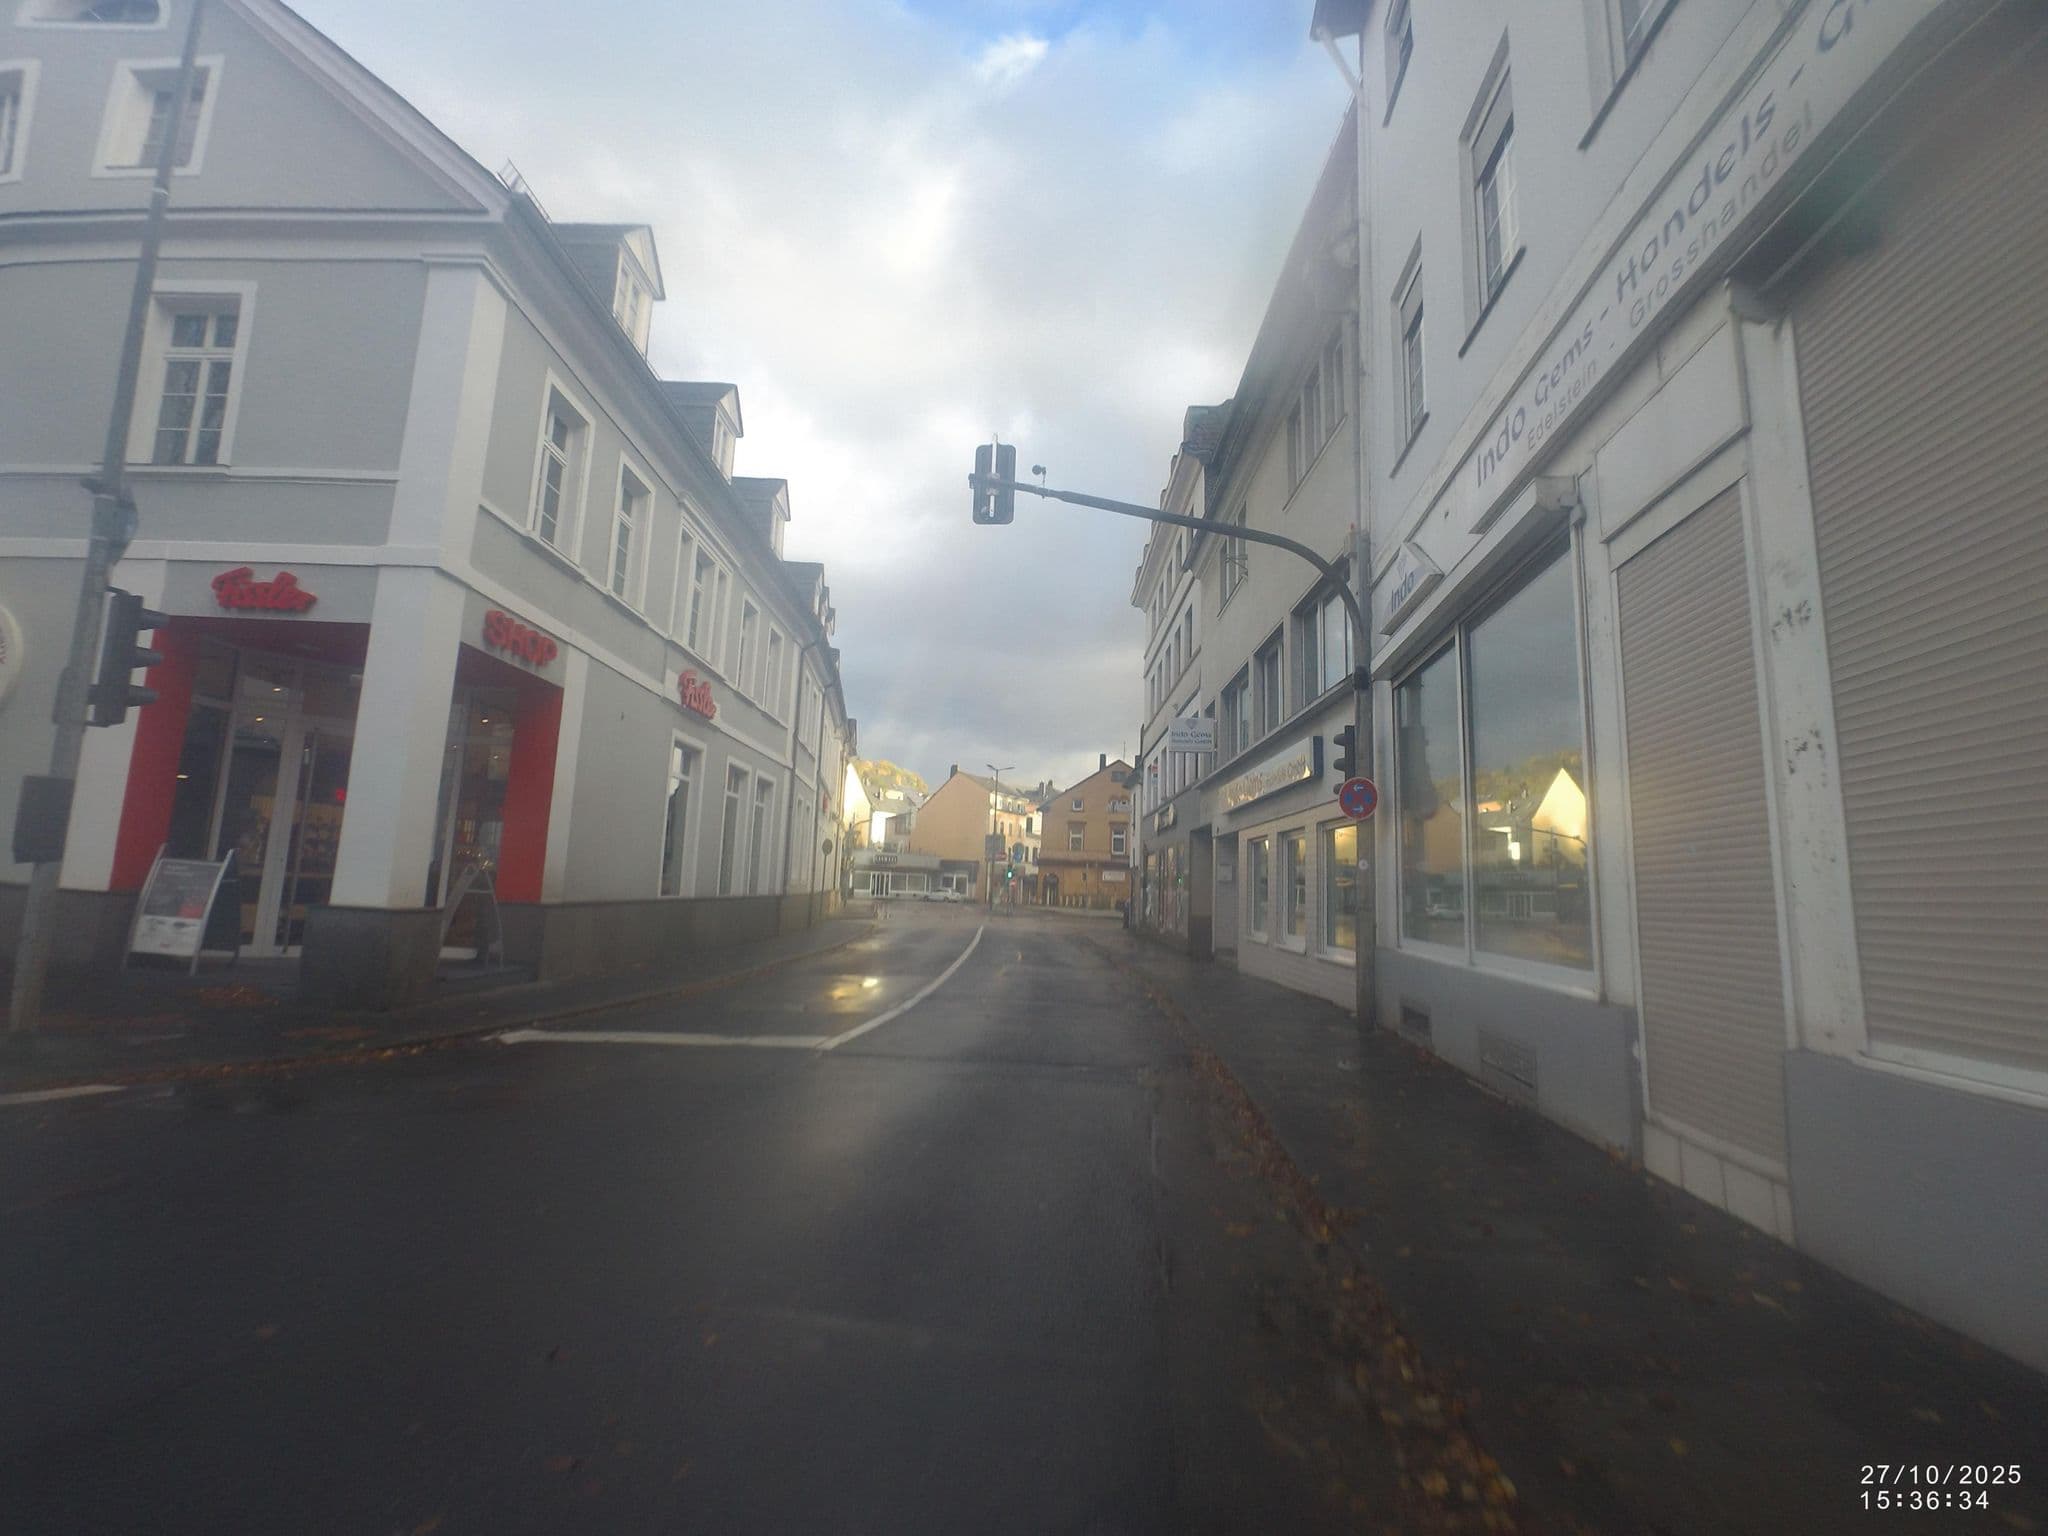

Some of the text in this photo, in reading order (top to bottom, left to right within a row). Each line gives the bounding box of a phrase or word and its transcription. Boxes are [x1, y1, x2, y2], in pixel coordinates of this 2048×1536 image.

[1477, 407, 1526, 488] Indo
[1534, 320, 1593, 407] Gems
[1616, 90, 1776, 303] Handels
[1528, 360, 1597, 450] Edelstein
[1630, 100, 1813, 329] Grosshandel
[482, 609, 558, 667] SHOP
[1391, 571, 1416, 613] Indo
